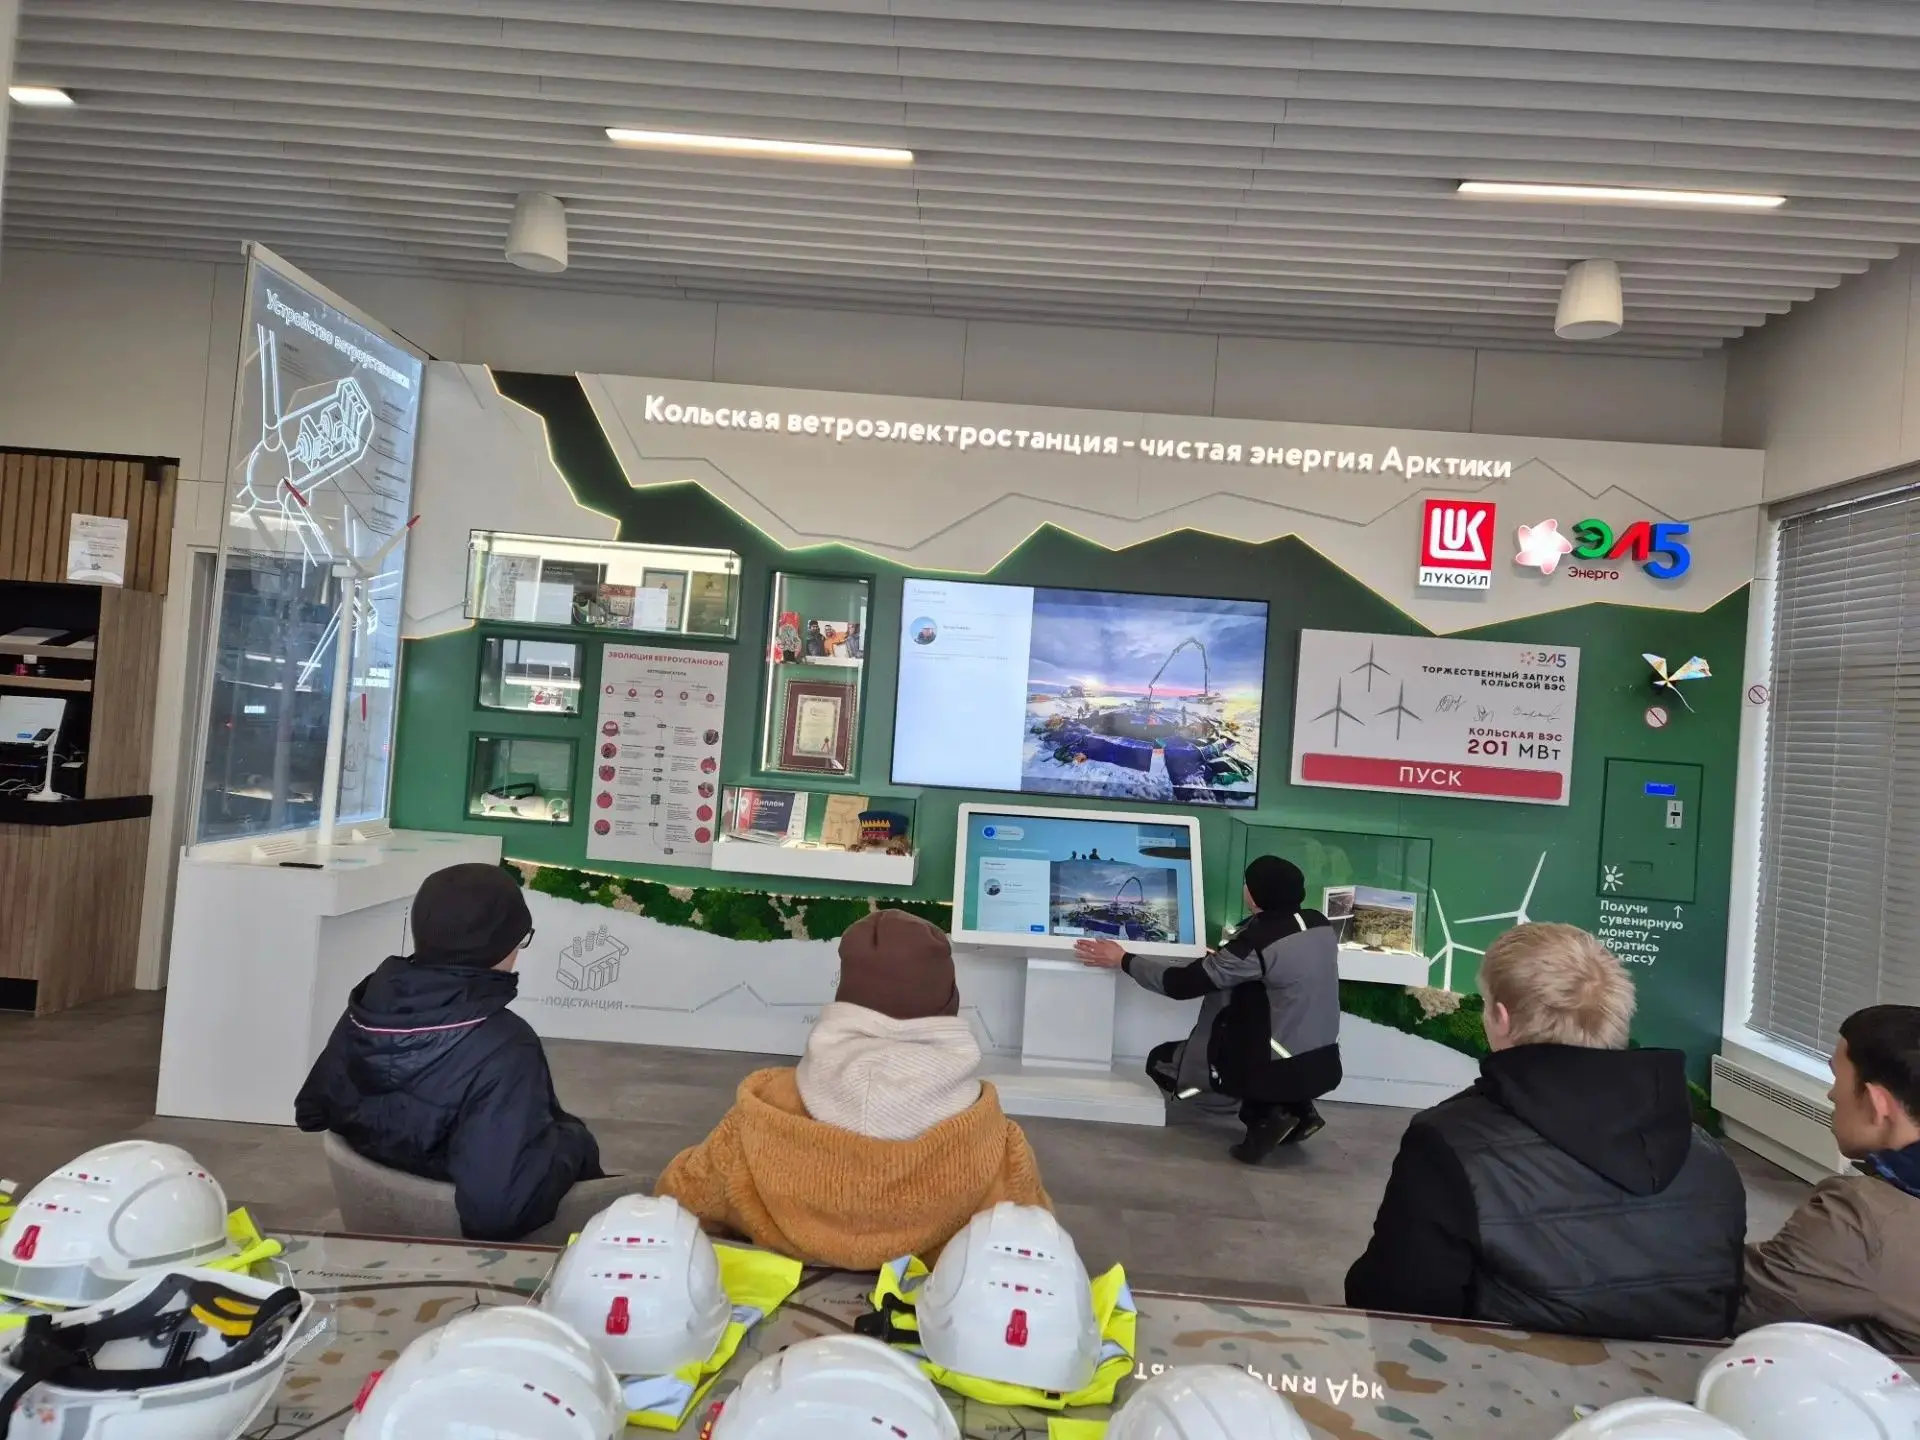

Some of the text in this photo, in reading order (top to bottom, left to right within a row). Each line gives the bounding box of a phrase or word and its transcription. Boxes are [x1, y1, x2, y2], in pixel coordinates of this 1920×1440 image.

[265, 288, 333, 344] Устройство
[644, 394, 780, 431] Кольская
[787, 412, 1118, 456] ветроэлектростанция
[1140, 438, 1242, 463] чистая
[1250, 445, 1373, 473] энергия
[1380, 446, 1512, 480] Арктики
[1571, 518, 1692, 580] ЭЛ5
[1421, 572, 1489, 587] ЛУКОЙЛ
[1567, 566, 1620, 581] Энерго
[607, 650, 725, 667] ЭВОЛЮЦИЯ ВЕТРОУСТАНОВОК
[1536, 652, 1567, 669] ЭЛ5
[1421, 665, 1566, 683] ТОРЖЕСТВЕННЫЙ ЗАПУСК
[1480, 678, 1567, 692] КОЛЬСКОЙ ВЭС
[1468, 727, 1563, 743] КОЛЬСКАЯ ВЭС
[1467, 738, 1562, 761] 201 МВт
[1398, 765, 1463, 787] ПУСК
[1600, 899, 1649, 915] Получи
[1599, 915, 1684, 931] сувенирную
[1597, 927, 1650, 942] монету
[545, 996, 624, 1011] ПОДСТАНЦИЯ
